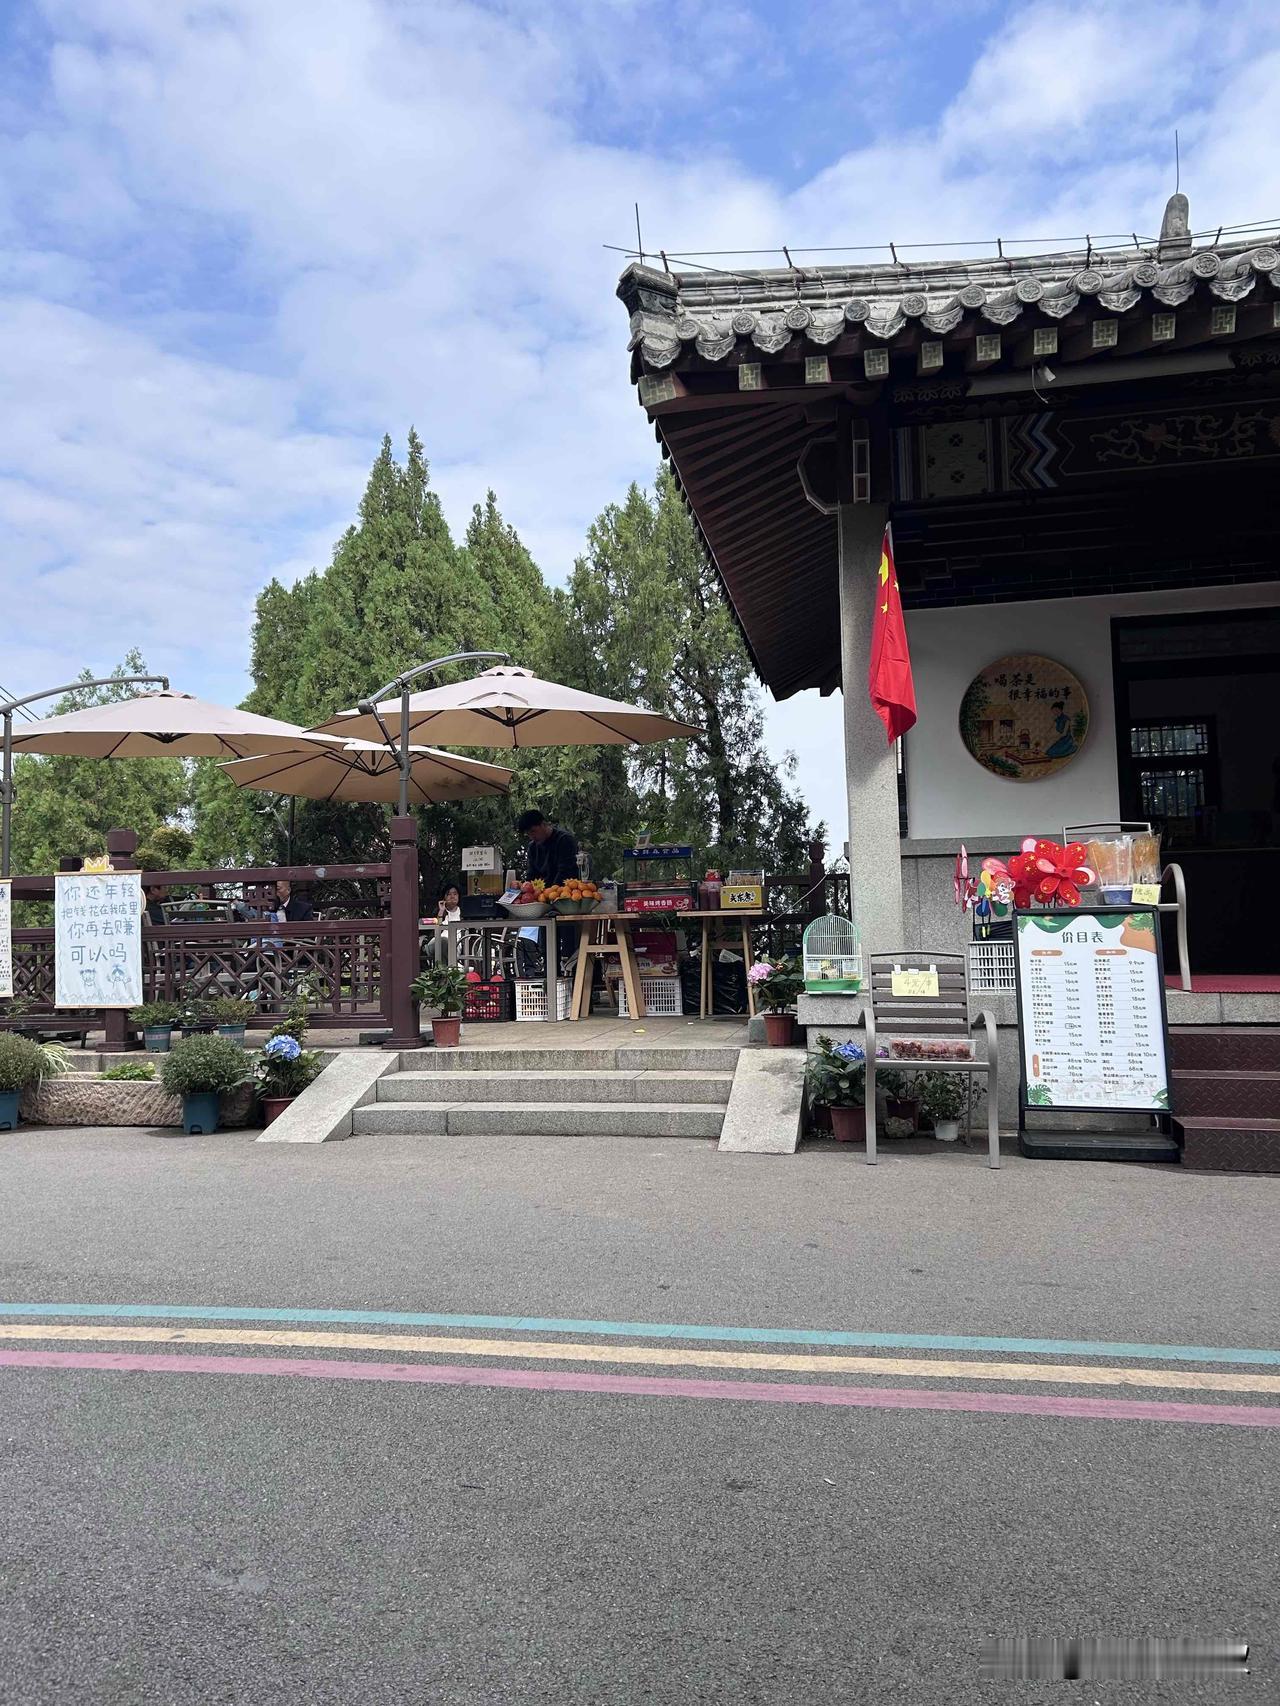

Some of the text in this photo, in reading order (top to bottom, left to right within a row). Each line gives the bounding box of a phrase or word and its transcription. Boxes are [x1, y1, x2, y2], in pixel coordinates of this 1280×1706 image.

[994, 673, 1037, 687] 喝茶是
[1008, 686, 1072, 701] 很幸福的事
[64, 883, 135, 901] 你还年轻
[61, 902, 138, 919] 把钱花在我店里
[67, 918, 135, 939] 你再去赚
[1061, 931, 1104, 944] 价目表
[70, 942, 127, 965] 可以吗
